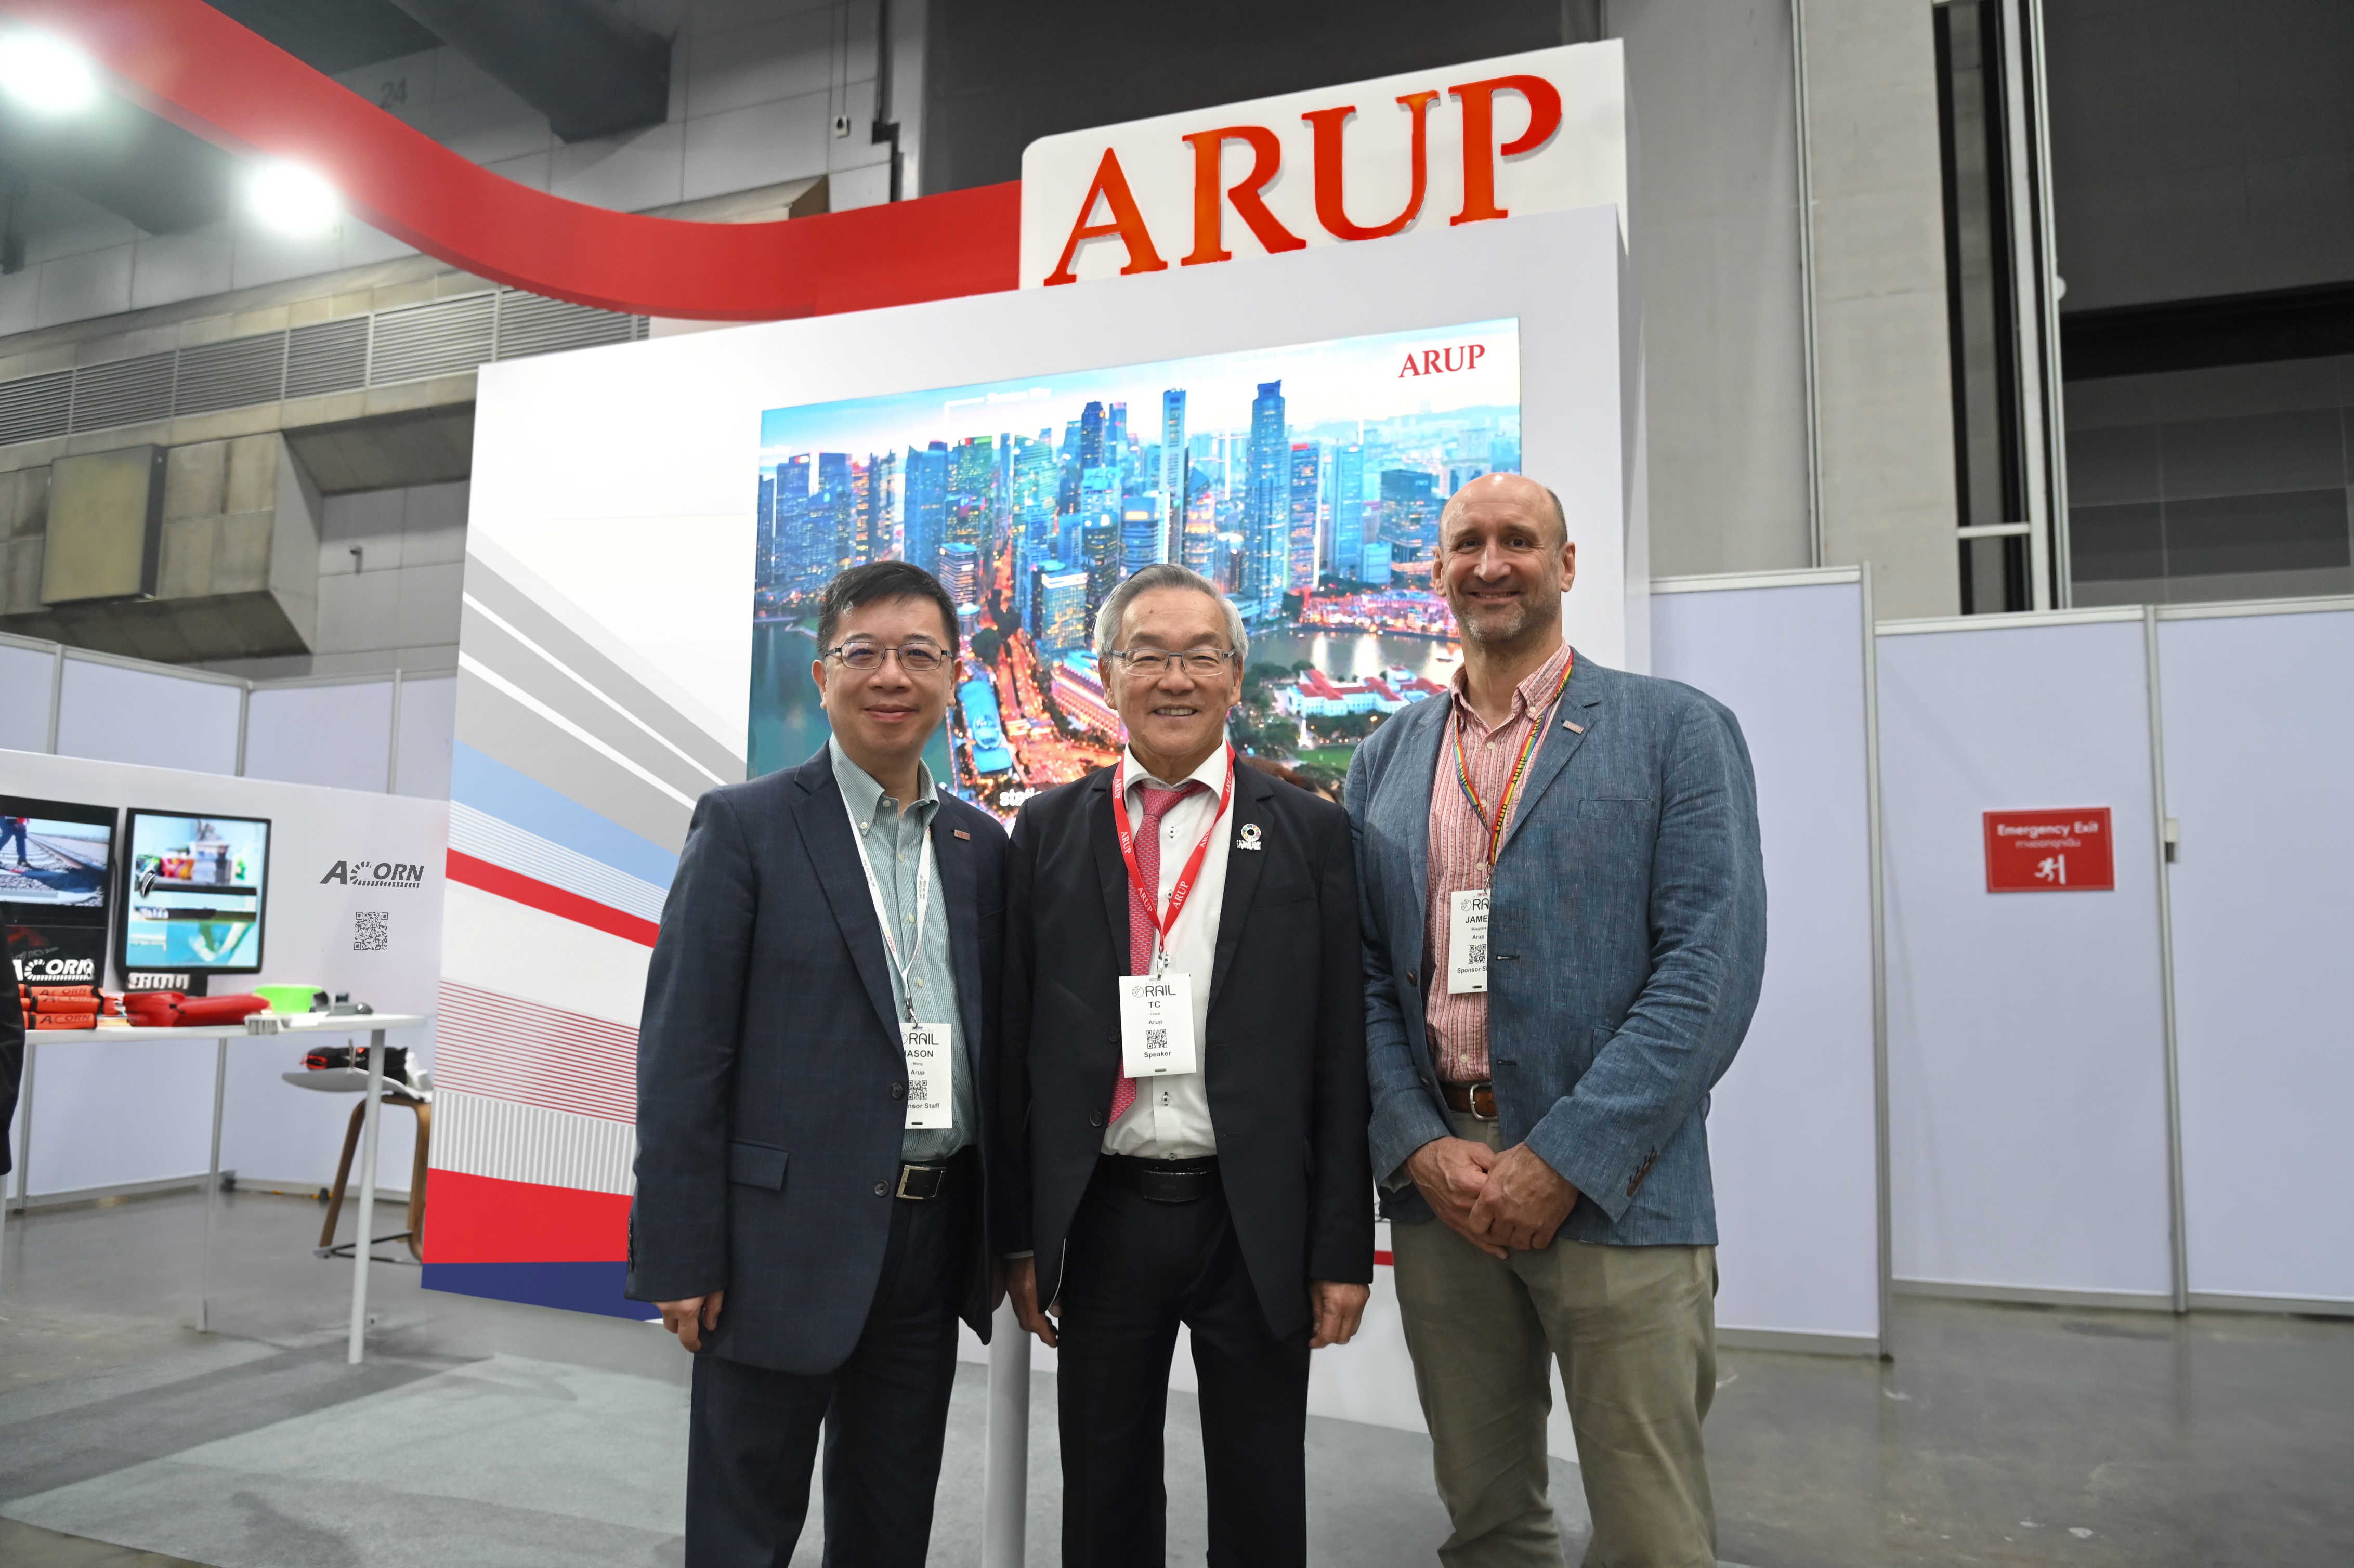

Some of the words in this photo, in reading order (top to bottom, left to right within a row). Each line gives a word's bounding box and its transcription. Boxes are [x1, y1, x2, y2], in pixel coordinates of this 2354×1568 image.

[1043, 74, 1562, 286] ARUP
[1398, 344, 1486, 378] ARUP
[1457, 762, 1468, 787] ARUP
[1511, 756, 1528, 785] ARUP
[1997, 824, 2071, 838] Emergency
[2073, 821, 2098, 833] Exit
[1121, 832, 1131, 854] ARUP
[319, 860, 425, 887] ACORN
[1137, 887, 1153, 911] ARUP
[1172, 881, 1188, 910] ARUP
[1473, 898, 1489, 911] RA
[1465, 914, 1488, 923] JAME
[1145, 985, 1176, 997] RAIL
[40, 1015, 90, 1024] ACORN
[909, 1033, 939, 1045] RAIL
